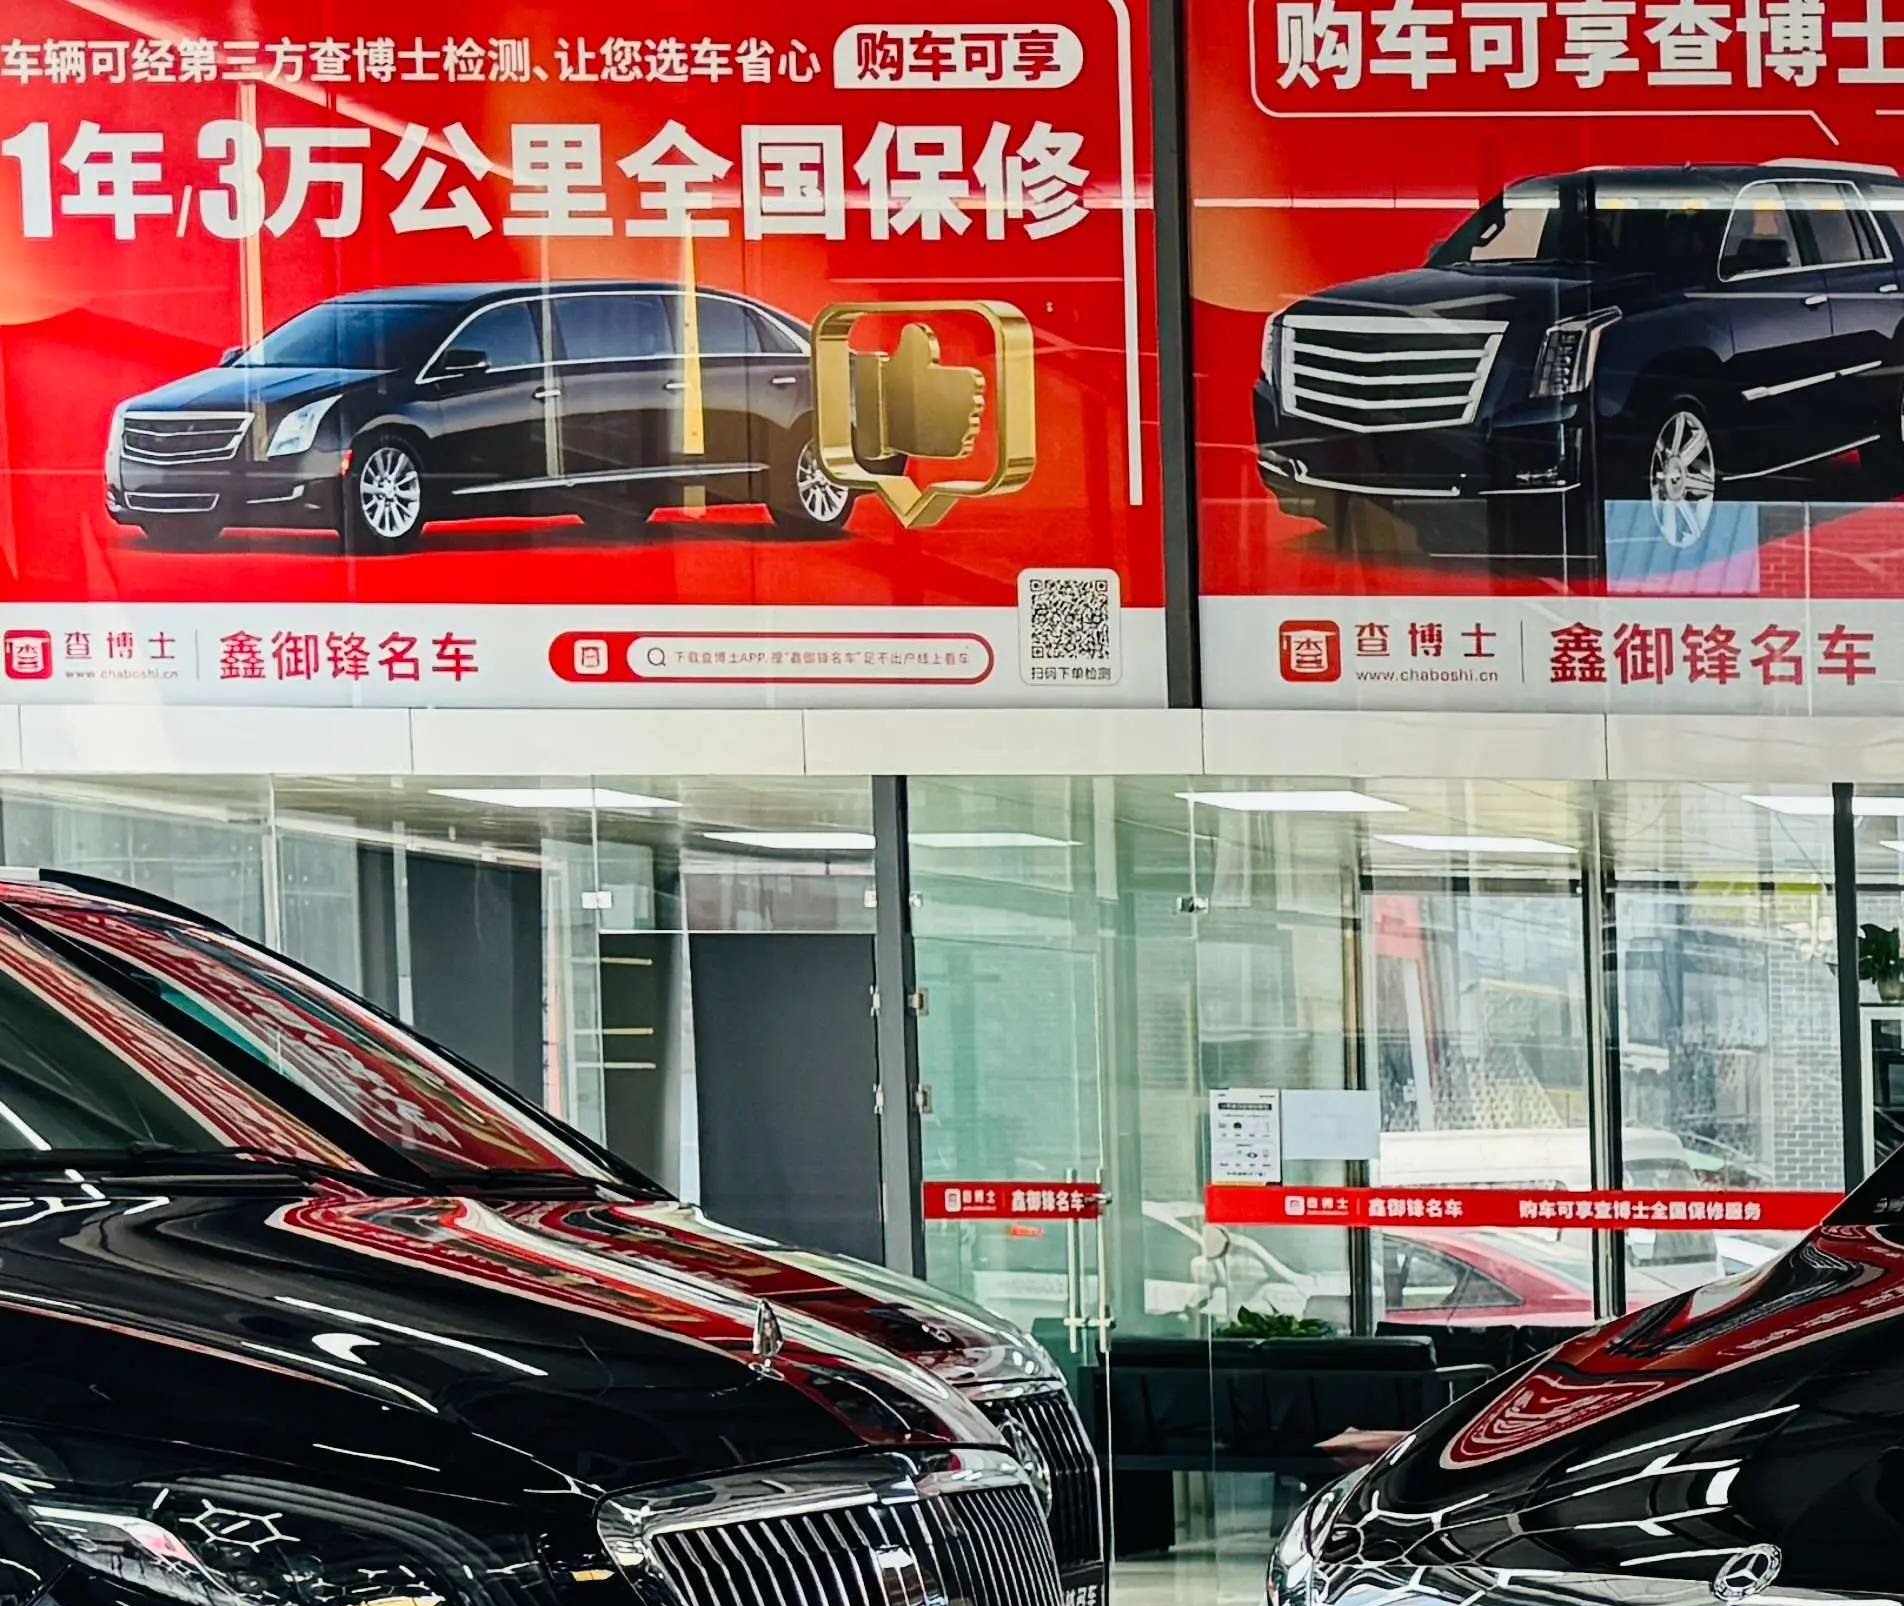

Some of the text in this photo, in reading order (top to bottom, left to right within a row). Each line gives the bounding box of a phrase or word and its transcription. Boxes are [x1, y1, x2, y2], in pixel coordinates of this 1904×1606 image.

[1, 30, 1062, 85] 车辆可经第三方查博士检测、让您选车省心 购车可享
[1, 118, 1091, 242] 1年/3万公里全国保修
[64, 631, 176, 660] 查博士
[219, 631, 479, 682] 鑫御锋名车
[1354, 622, 1497, 659] 查博士
[1550, 622, 1877, 686] 鑫御锋名车
[1356, 669, 1498, 684] www.chaboshi.cn
[1368, 1198, 1464, 1218] 鑫御锋名车
